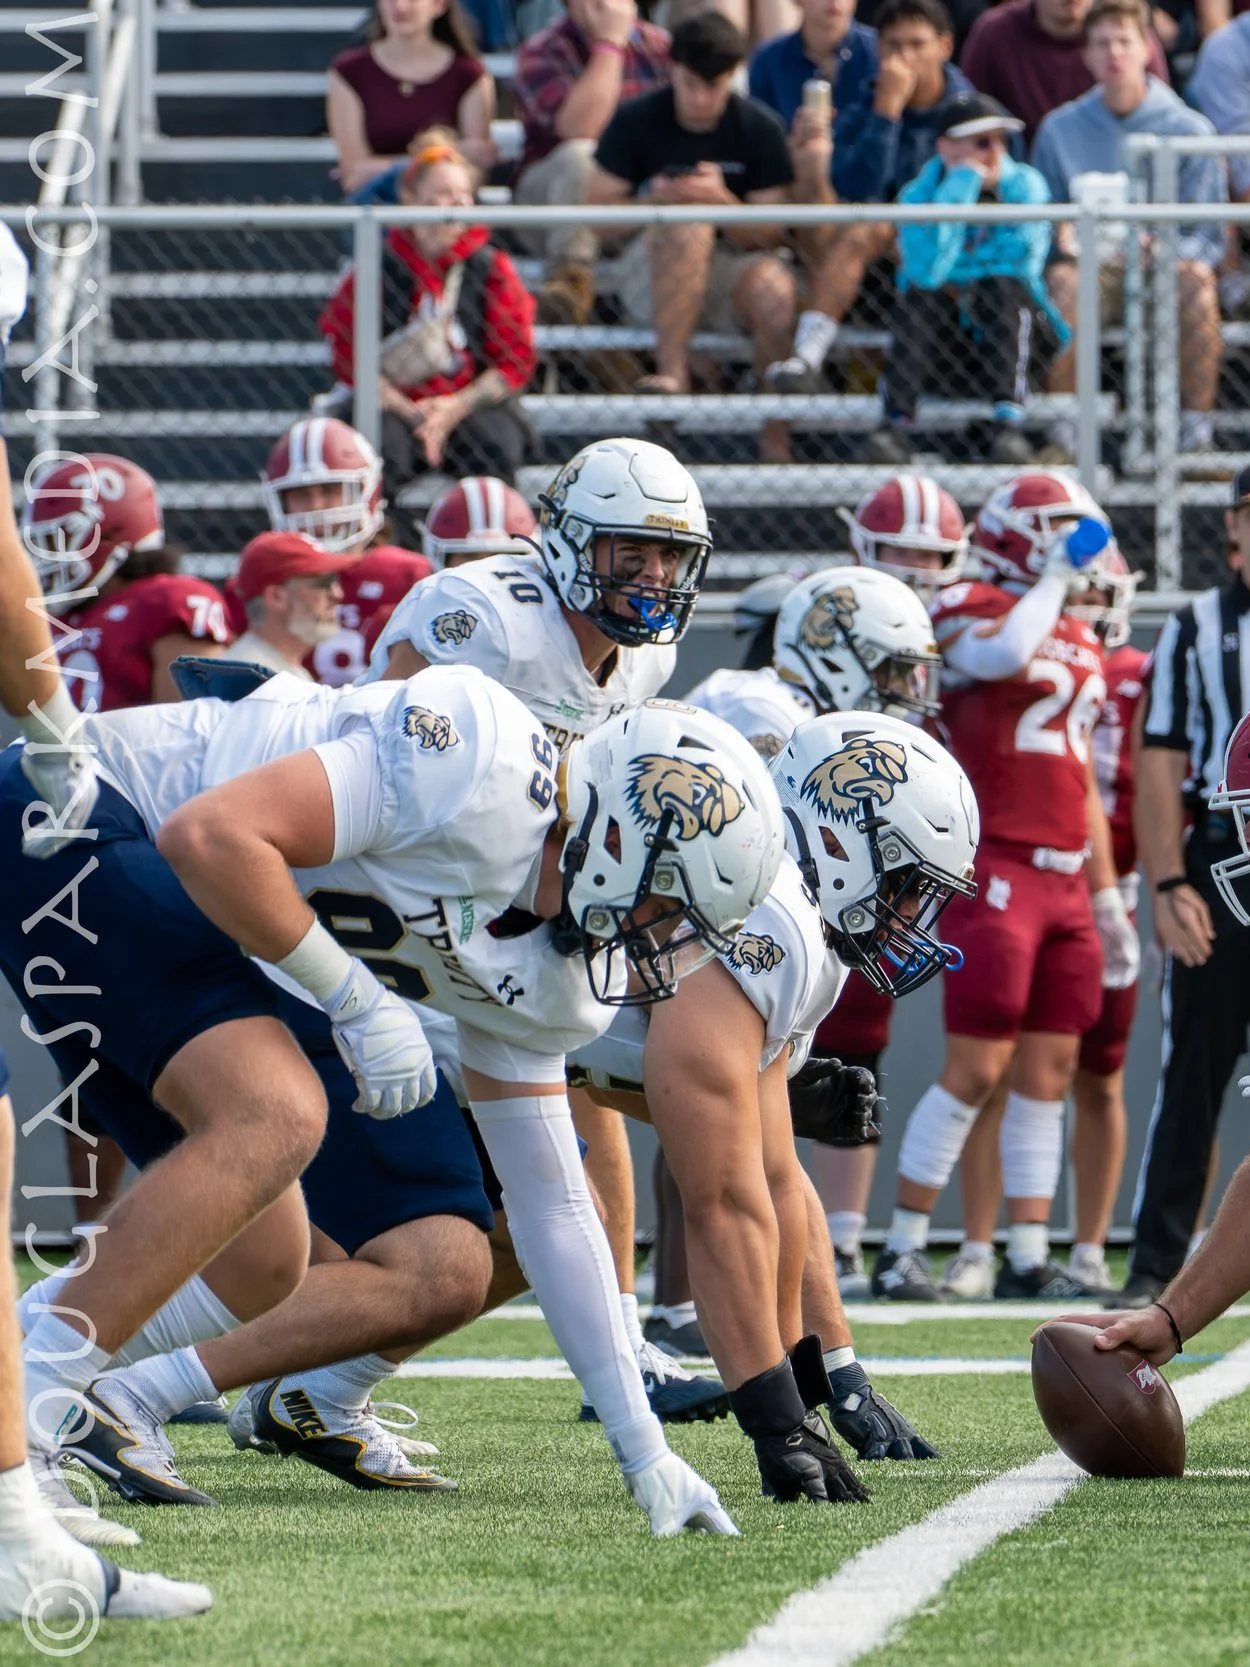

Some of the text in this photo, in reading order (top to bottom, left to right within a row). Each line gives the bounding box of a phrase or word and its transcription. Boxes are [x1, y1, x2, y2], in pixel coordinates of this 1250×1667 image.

[489, 569, 544, 607] 10
[1015, 658, 1108, 764] 26
[279, 1387, 330, 1440] NIKE
